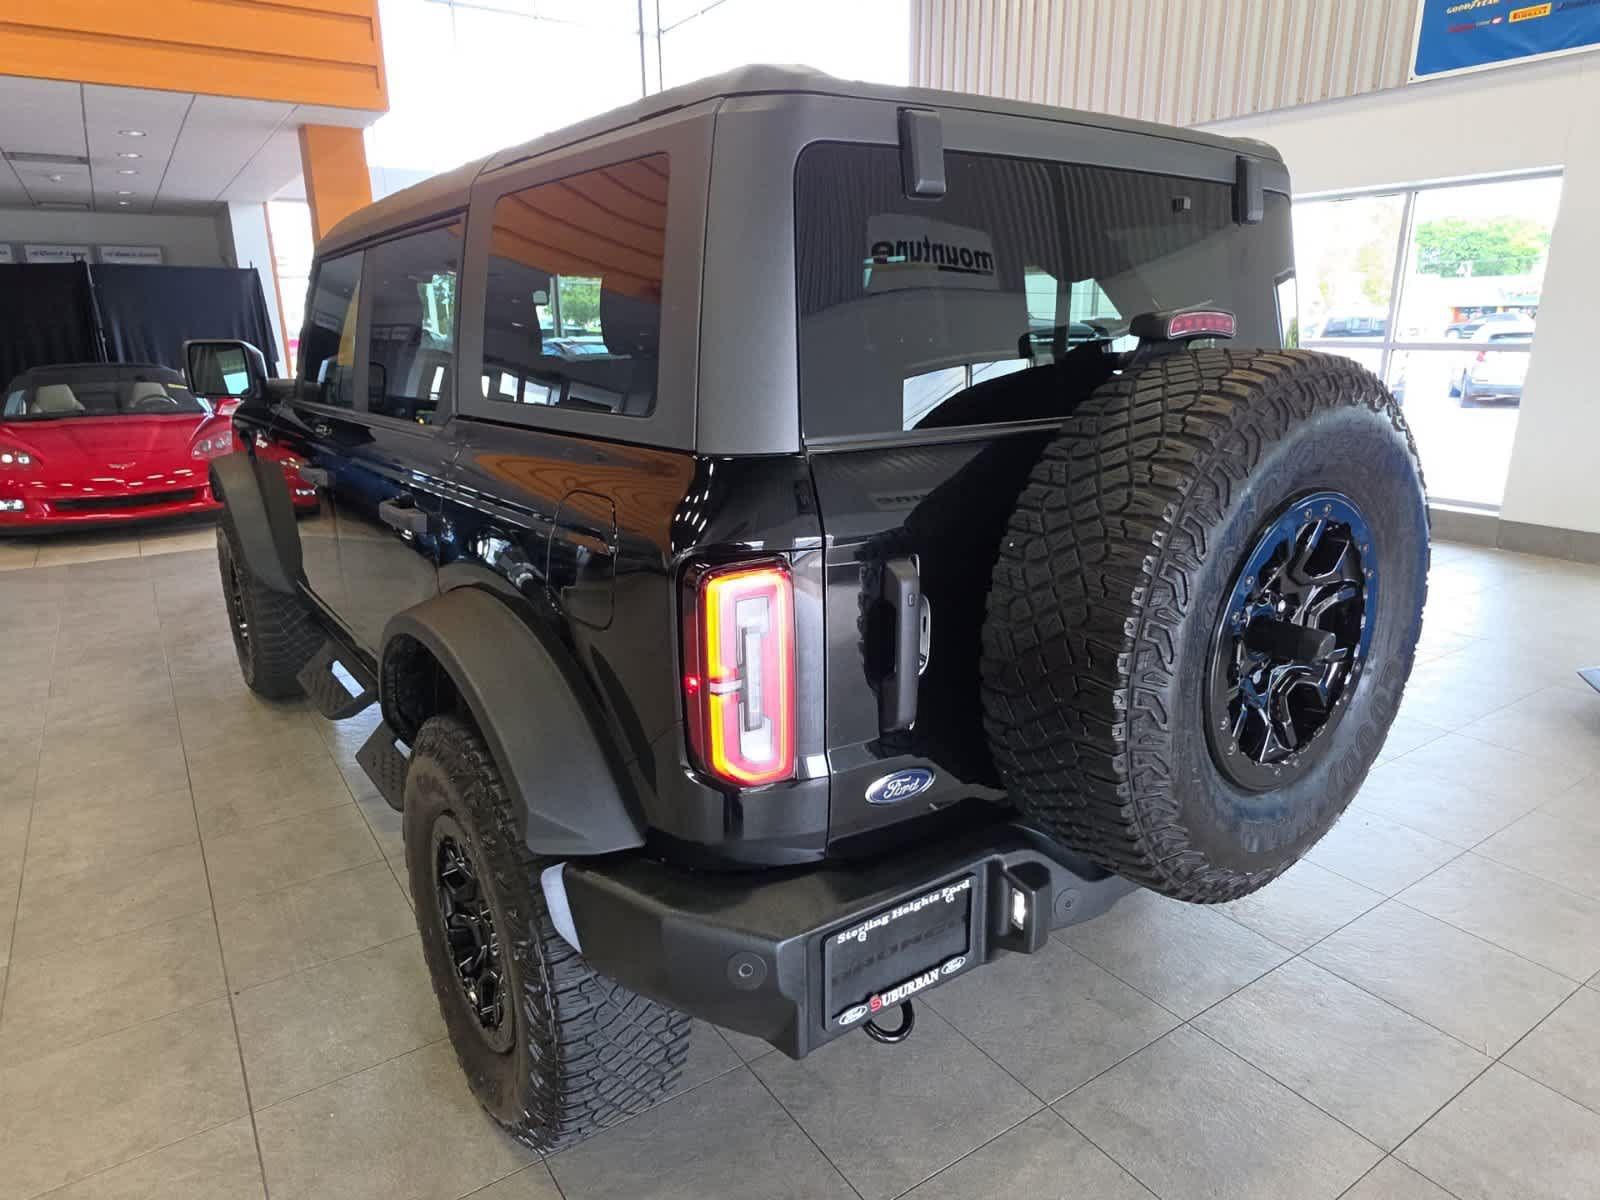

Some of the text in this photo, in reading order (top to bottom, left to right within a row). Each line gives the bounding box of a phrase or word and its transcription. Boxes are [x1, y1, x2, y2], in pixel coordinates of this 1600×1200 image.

[883, 775, 920, 799] Ford
[837, 879, 970, 944] Sterling Heights Ford
[869, 968, 940, 1012] SUBURBAN
